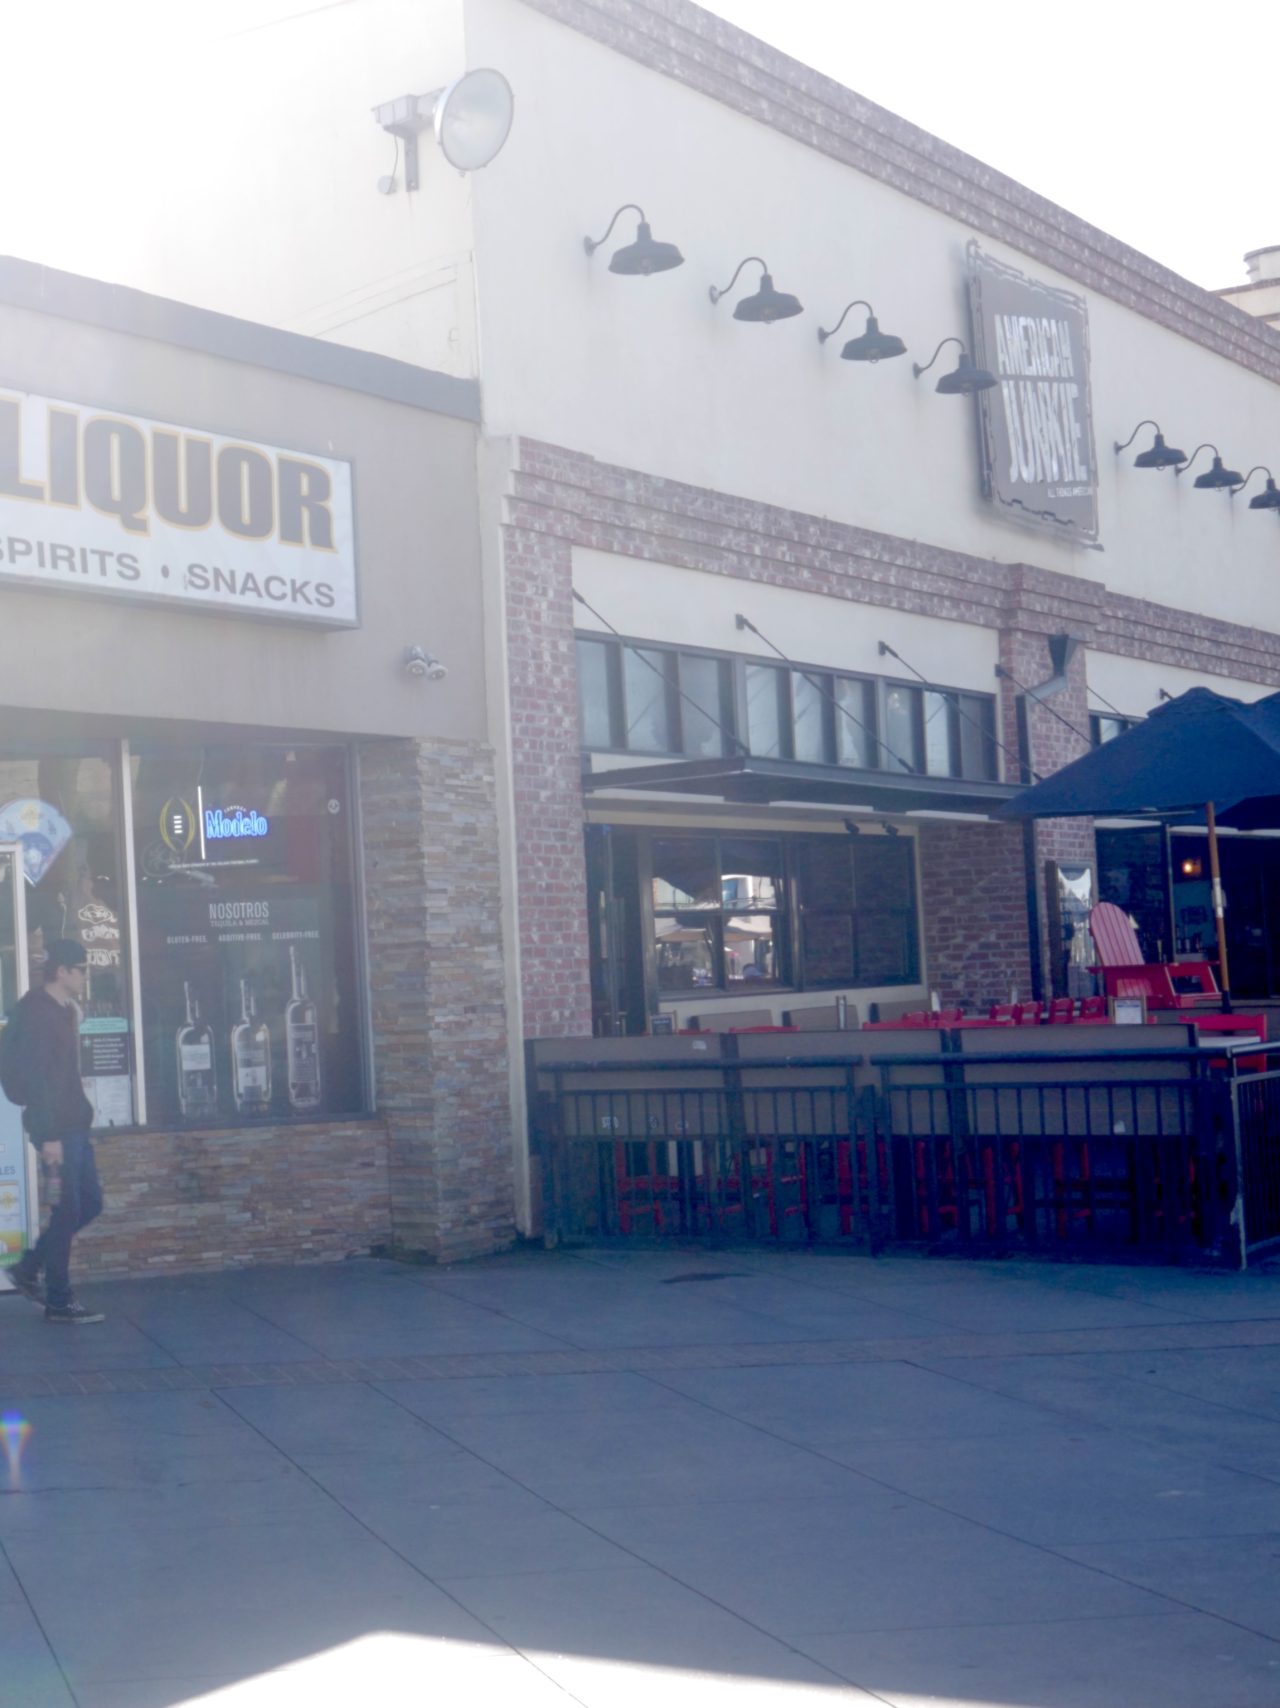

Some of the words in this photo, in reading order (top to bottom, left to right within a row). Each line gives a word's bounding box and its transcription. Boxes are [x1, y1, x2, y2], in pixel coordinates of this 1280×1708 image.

[994, 313, 1075, 379] AMERICAN
[1001, 380, 1089, 484] JUNKIE
[186, 564, 336, 608] SNACKS
[206, 809, 269, 839] Modelo
[209, 902, 270, 920] NOSOTROS
